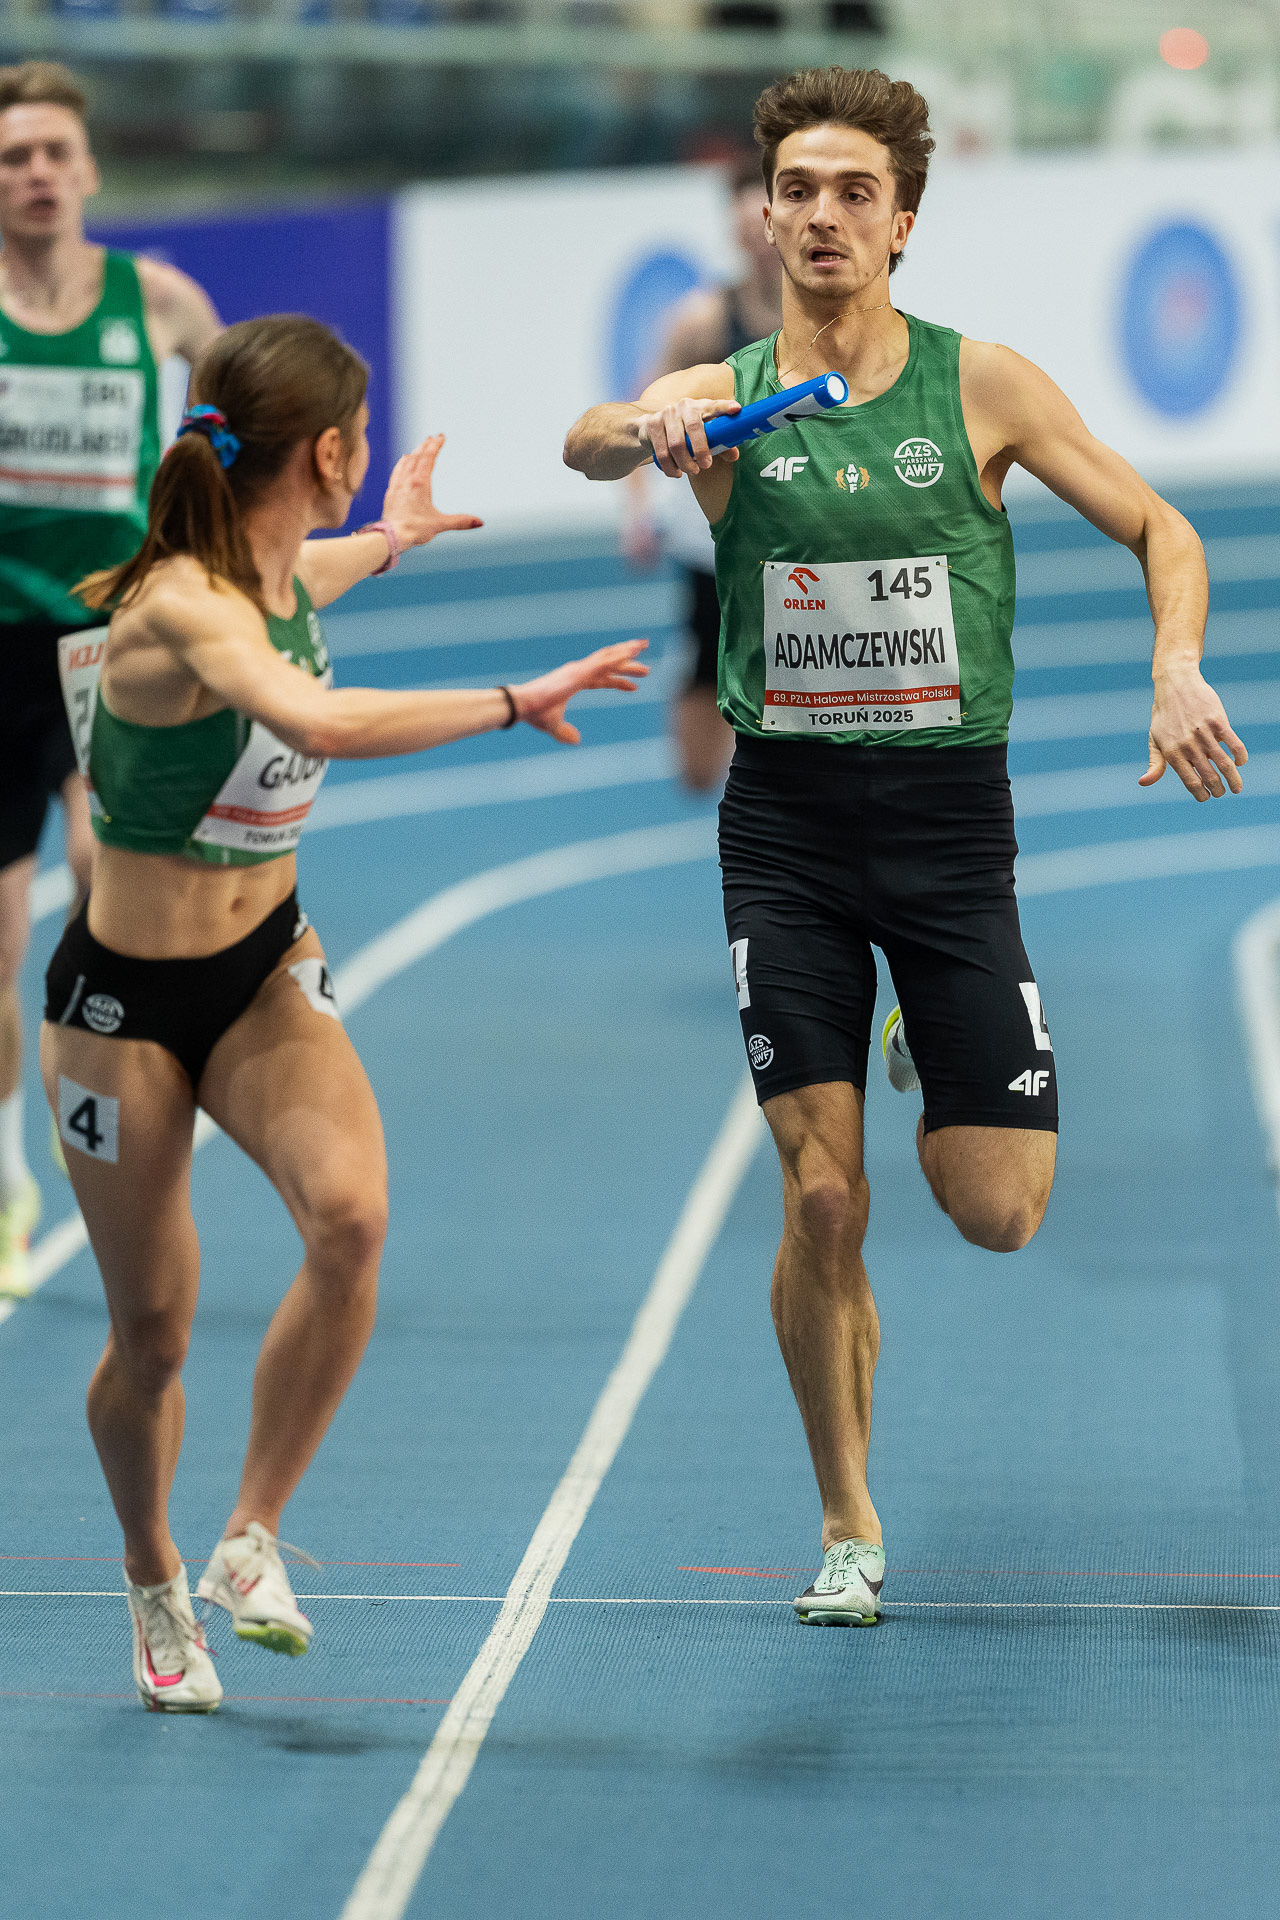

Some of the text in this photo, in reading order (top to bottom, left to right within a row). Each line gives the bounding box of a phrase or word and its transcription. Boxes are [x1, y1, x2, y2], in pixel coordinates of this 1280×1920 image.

[904, 445, 932, 458] AZS
[760, 456, 809, 482] 4F
[904, 463, 937, 478] AWF
[867, 566, 932, 602] 145
[783, 598, 826, 611] ORLEN
[775, 627, 946, 670] ADAMCZEWSKI
[773, 688, 952, 705] 69. PZLA Halowe Mistrzostwa Polski
[808, 707, 914, 726] TORUŃ 2025
[1008, 1069, 1050, 1096] 4F
[68, 1096, 104, 1151] 4
